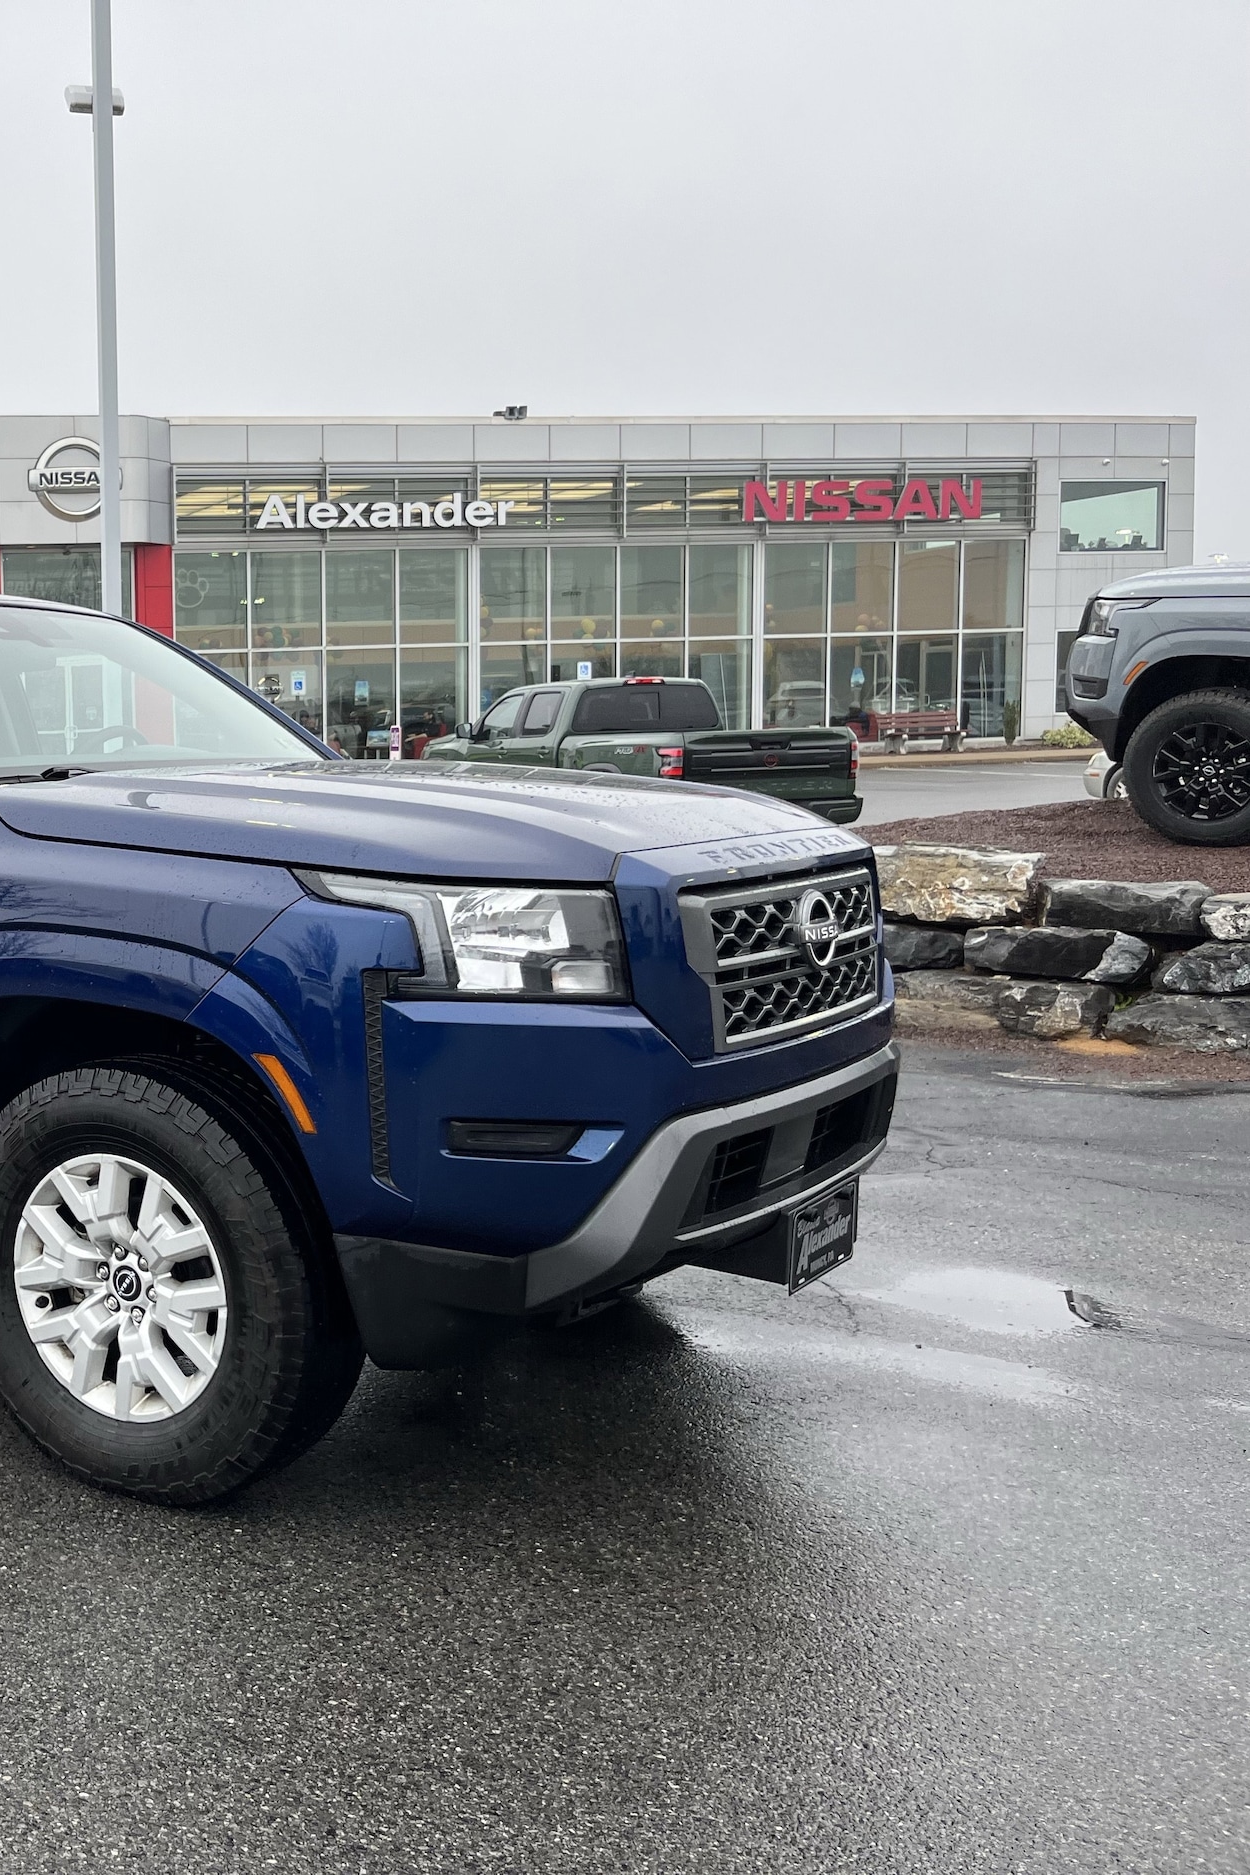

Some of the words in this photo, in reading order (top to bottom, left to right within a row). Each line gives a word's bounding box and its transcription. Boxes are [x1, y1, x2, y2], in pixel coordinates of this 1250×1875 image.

[38, 471, 100, 487] NISSA
[255, 493, 515, 530] Alexander
[742, 479, 983, 522] NISSAN
[697, 834, 853, 864] FRONTIER
[796, 1214, 851, 1275] Alexander
